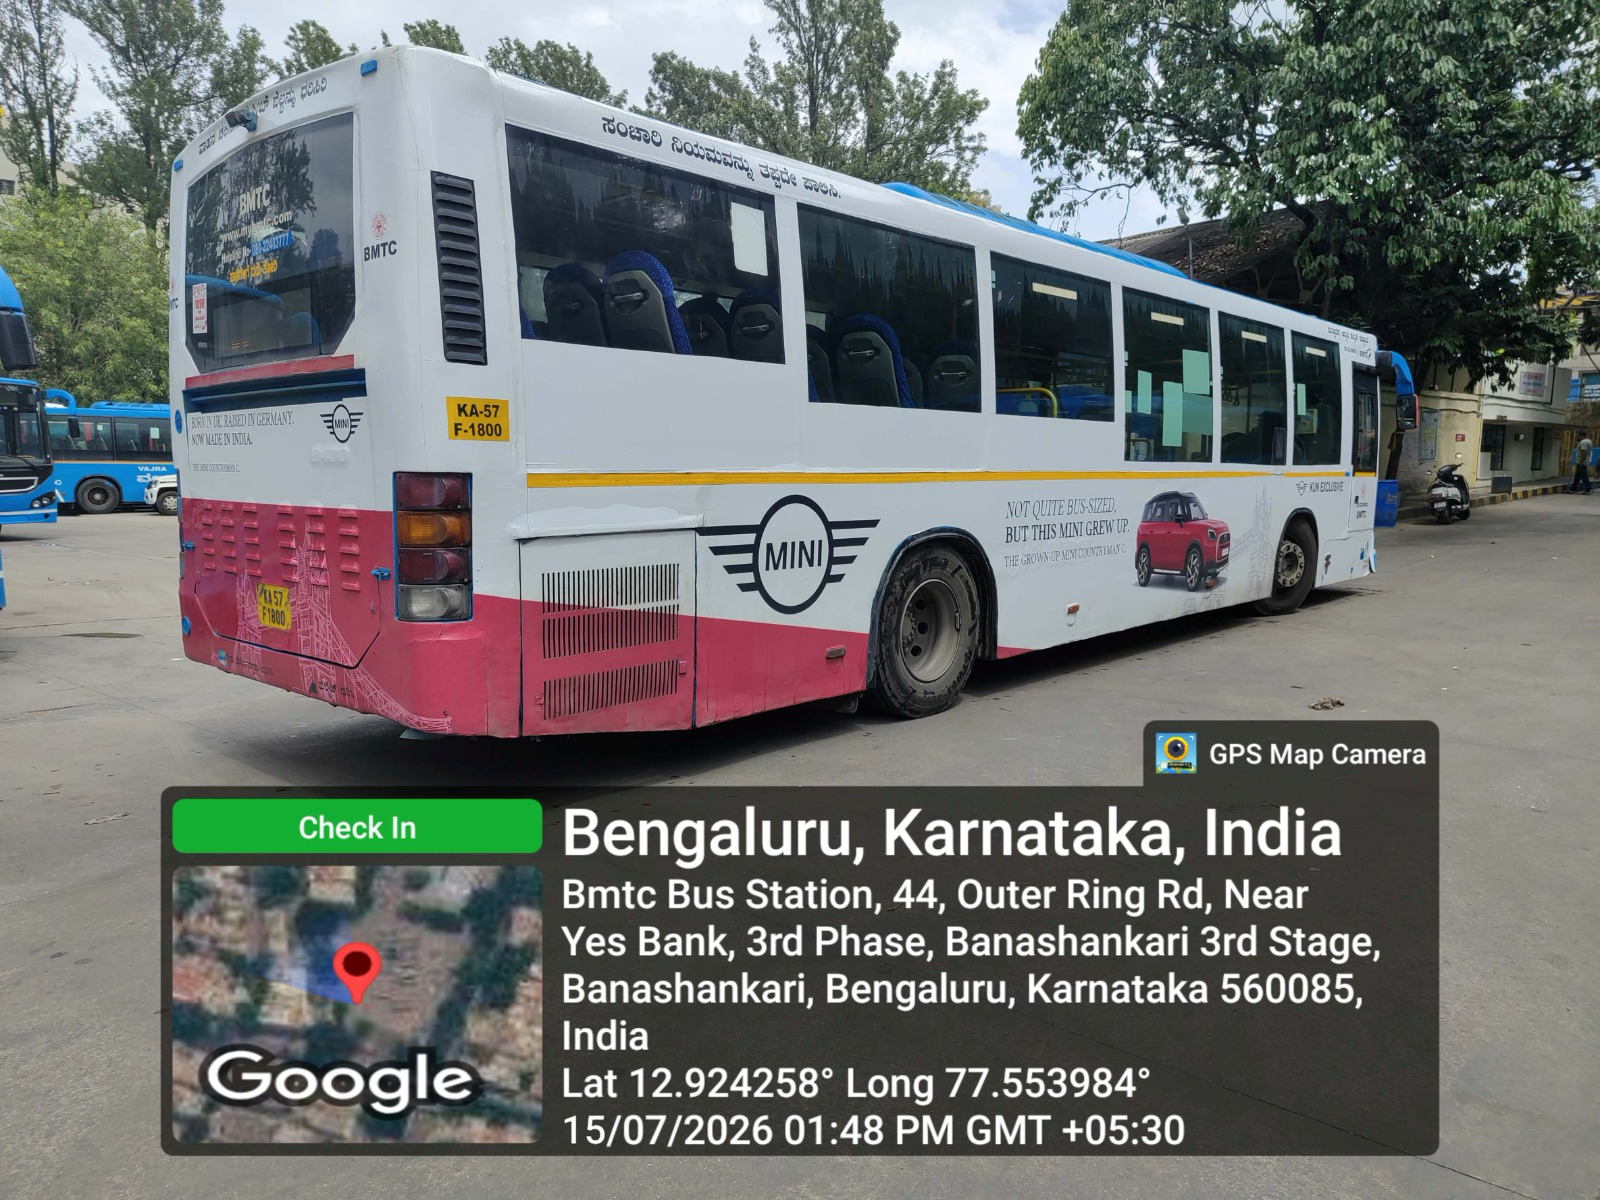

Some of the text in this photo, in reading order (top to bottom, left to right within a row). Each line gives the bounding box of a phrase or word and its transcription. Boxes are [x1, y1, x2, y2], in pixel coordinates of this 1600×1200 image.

[601, 115, 663, 147] ಸಂಚಾರಿ
[671, 136, 754, 181] ನಿಯಮವನ್ನು
[759, 162, 797, 189] ತಪ್ಪದೇ
[240, 183, 270, 216] BMTC
[364, 240, 398, 262] BMTC
[191, 416, 206, 429] BORN
[224, 413, 247, 428] RAISED
[248, 413, 256, 426] IN
[257, 411, 294, 426] GERMANY.
[457, 403, 500, 418] KA-57
[334, 418, 349, 429] MINI
[454, 422, 502, 437] F-1800
[191, 433, 205, 446] NOW
[206, 433, 222, 445] MADE
[223, 433, 231, 445] IN
[1320, 481, 1344, 492] EXCLUSIVE
[1005, 497, 1117, 521] NOT QUITE BUS-SIZED,
[1005, 518, 1130, 543] BUT THIS MINI GREW UP.
[765, 539, 823, 572] MINI
[1004, 555, 1020, 567] THE
[1021, 550, 1061, 566] GROWN-UP
[1061, 548, 1077, 561] MINI
[1078, 543, 1121, 559] COUNTRYMAN
[263, 589, 283, 607] KA 57
